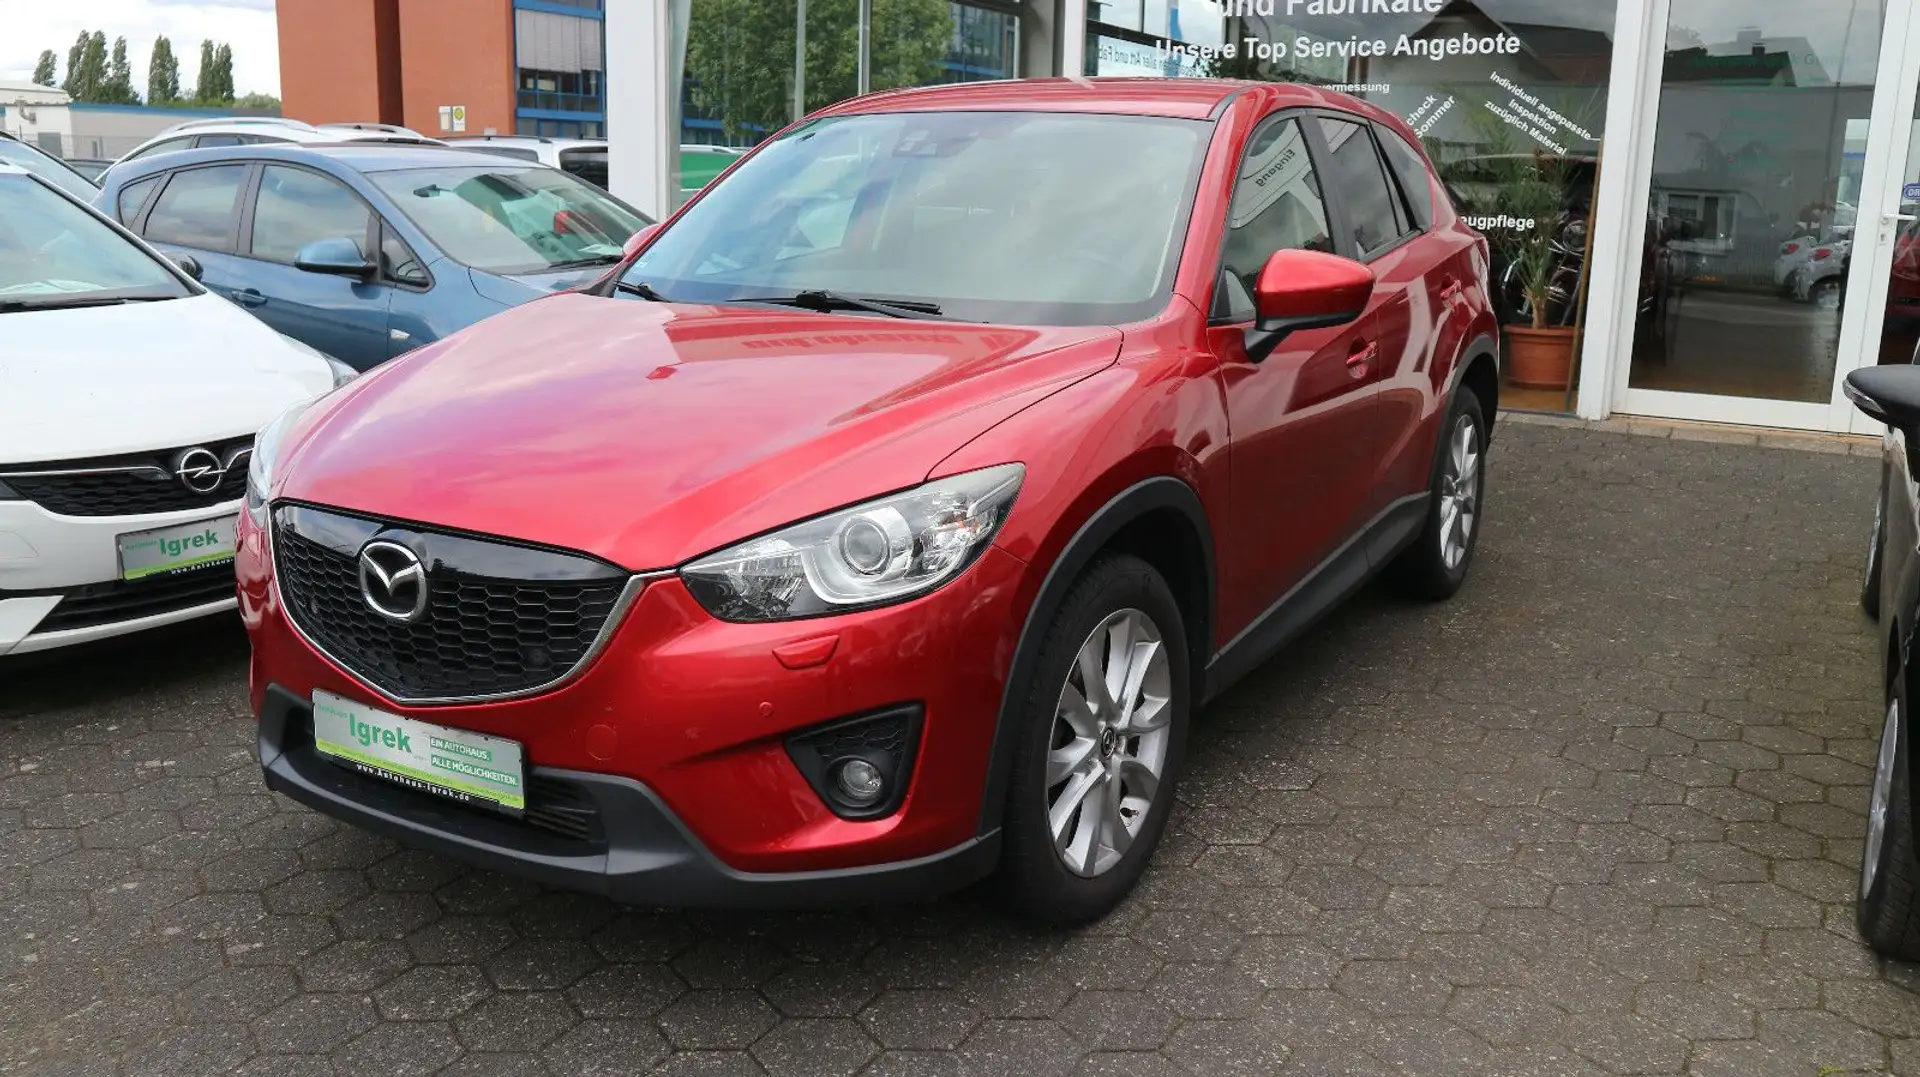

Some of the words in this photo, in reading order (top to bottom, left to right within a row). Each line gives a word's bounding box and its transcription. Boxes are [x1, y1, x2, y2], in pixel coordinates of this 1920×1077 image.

[1220, 0, 1274, 17] und
[1286, 0, 1443, 16] Fabrikate
[1155, 38, 1235, 60] Unsere
[1243, 36, 1287, 63] Top
[1294, 34, 1386, 58] Service
[1392, 31, 1521, 62] Angebote
[1406, 94, 1438, 126] check
[1414, 95, 1456, 139] Sommer
[1489, 70, 1539, 108] Individuell
[1537, 102, 1592, 141] angepasste
[1508, 98, 1558, 135] Inspektion
[1484, 99, 1529, 132] zuzüglich
[1528, 126, 1568, 156] Material
[159, 529, 219, 557] Igrek
[349, 712, 412, 754] Igrek
[430, 739, 444, 749] EIN
[432, 756, 452, 769] ALLE
